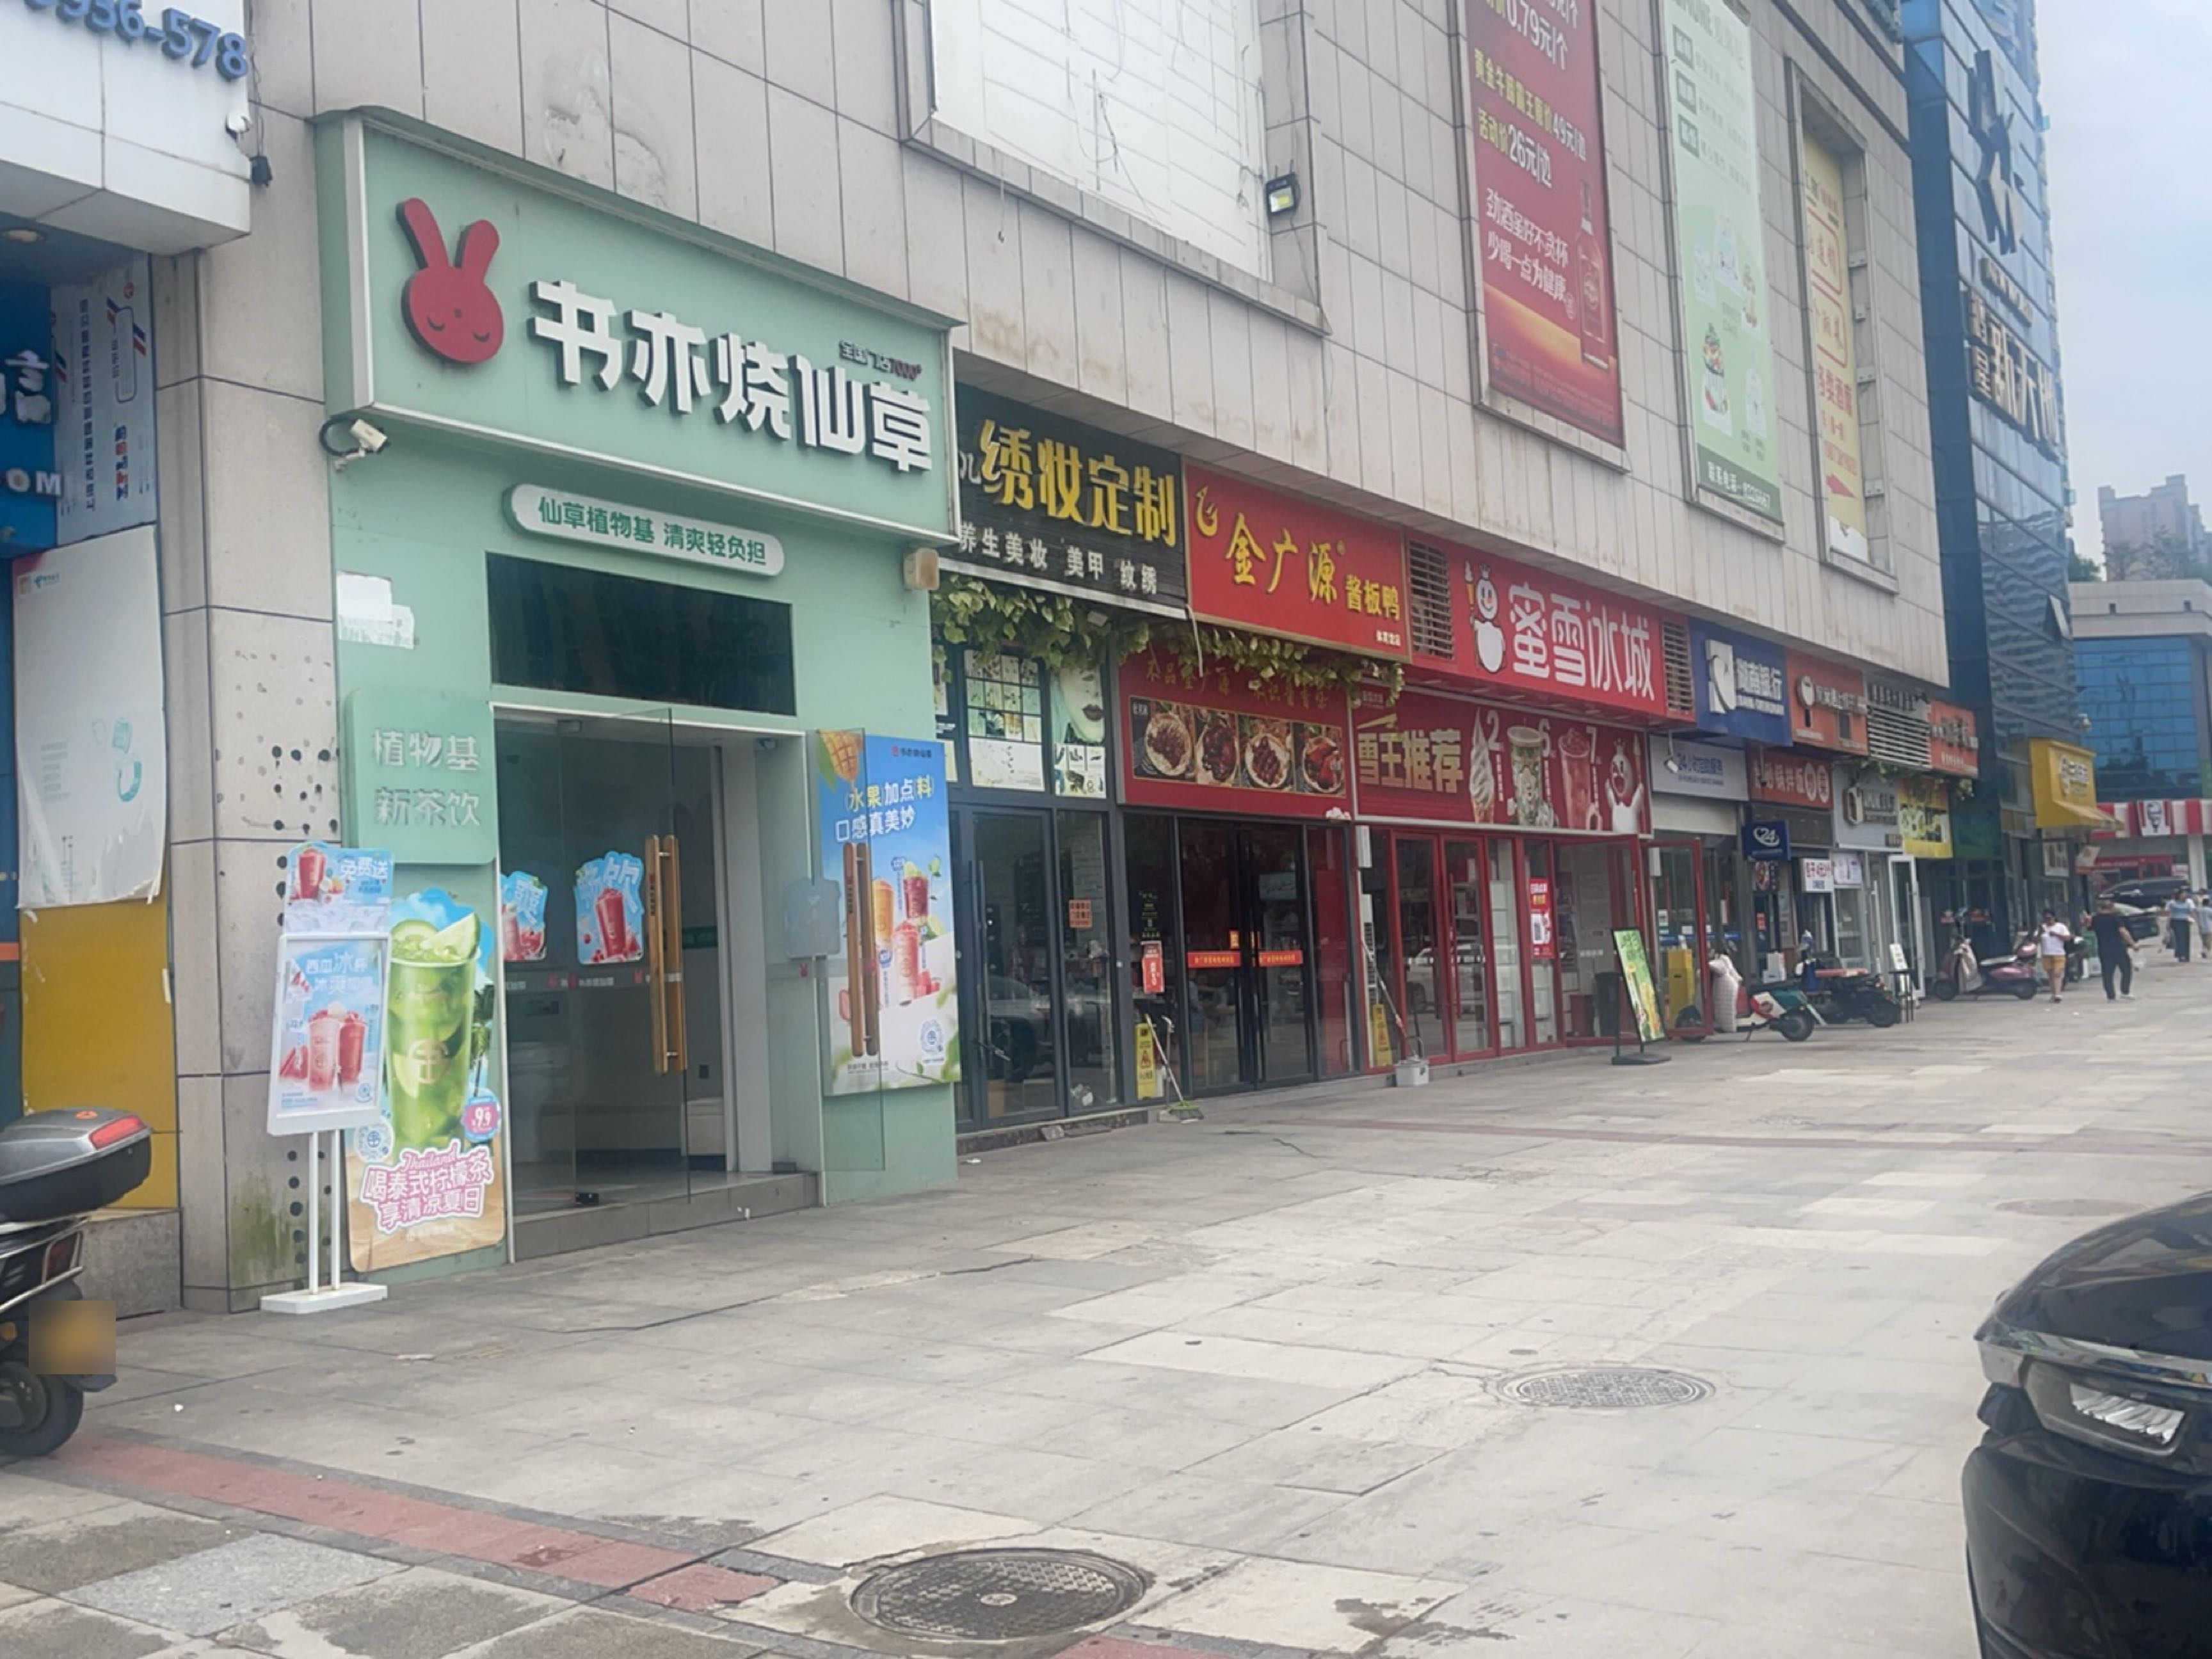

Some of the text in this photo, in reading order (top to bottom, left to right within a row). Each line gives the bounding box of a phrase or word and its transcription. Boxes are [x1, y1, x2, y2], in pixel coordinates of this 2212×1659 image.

[529, 280, 932, 472] 书亦烧仙草
[979, 419, 1176, 547] 绣妆定制
[538, 496, 767, 566] 仙草植物基 清爽轻负担
[959, 521, 1048, 571] 养生美妆
[1064, 546, 1104, 580] 美甲
[1225, 513, 1400, 621] 金广源 酱板鸭
[1509, 581, 1655, 701] 蜜雪冰城
[373, 728, 480, 771] 植物基
[1358, 728, 1464, 794] 雪王推荐
[375, 787, 481, 826] 新茶饮
[835, 805, 915, 842] 口感真美妙
[341, 856, 389, 881] 免费送
[365, 1150, 492, 1200] 喝泰式柠檬茶
[405, 1142, 458, 1171] Thailand
[380, 1187, 481, 1230] 享清凉夏日
